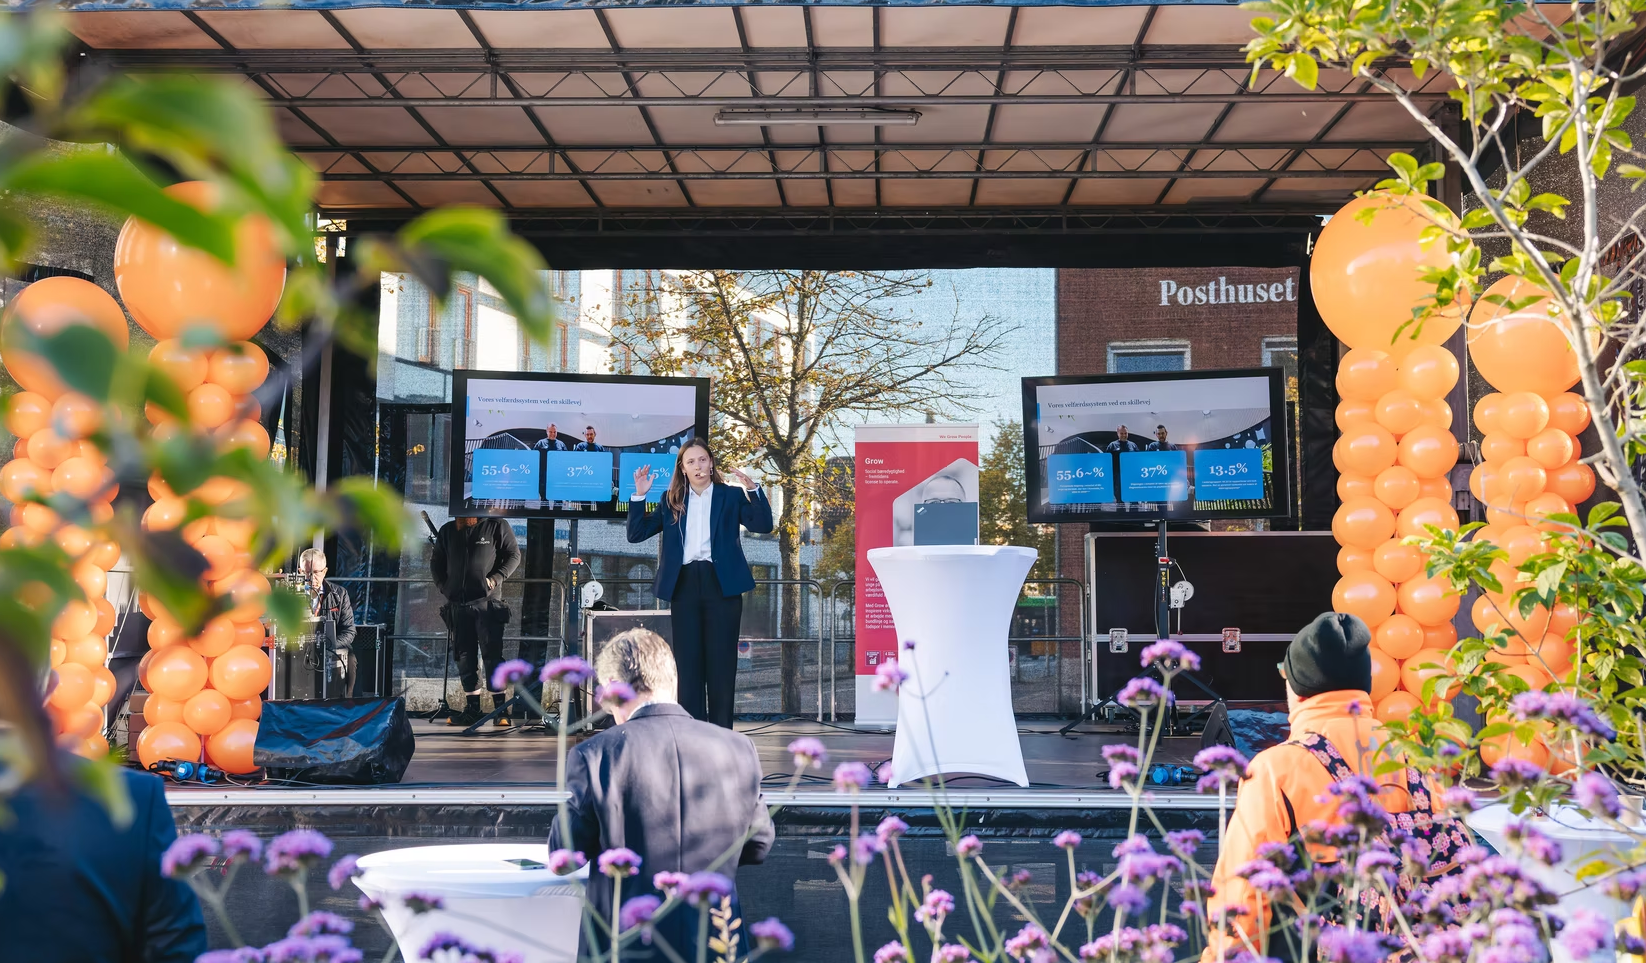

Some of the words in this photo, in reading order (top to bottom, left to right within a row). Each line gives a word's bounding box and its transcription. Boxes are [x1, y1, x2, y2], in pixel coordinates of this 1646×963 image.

[1158, 276, 1297, 306] Posthuset
[495, 397, 538, 405] velfærdssystem
[1065, 400, 1108, 409] velfærdssystem
[1127, 398, 1151, 406] skillevej
[864, 457, 884, 465] Grow
[566, 464, 594, 478] 37%
[1140, 464, 1168, 479] 37%
[1208, 462, 1248, 477] 13.5%
